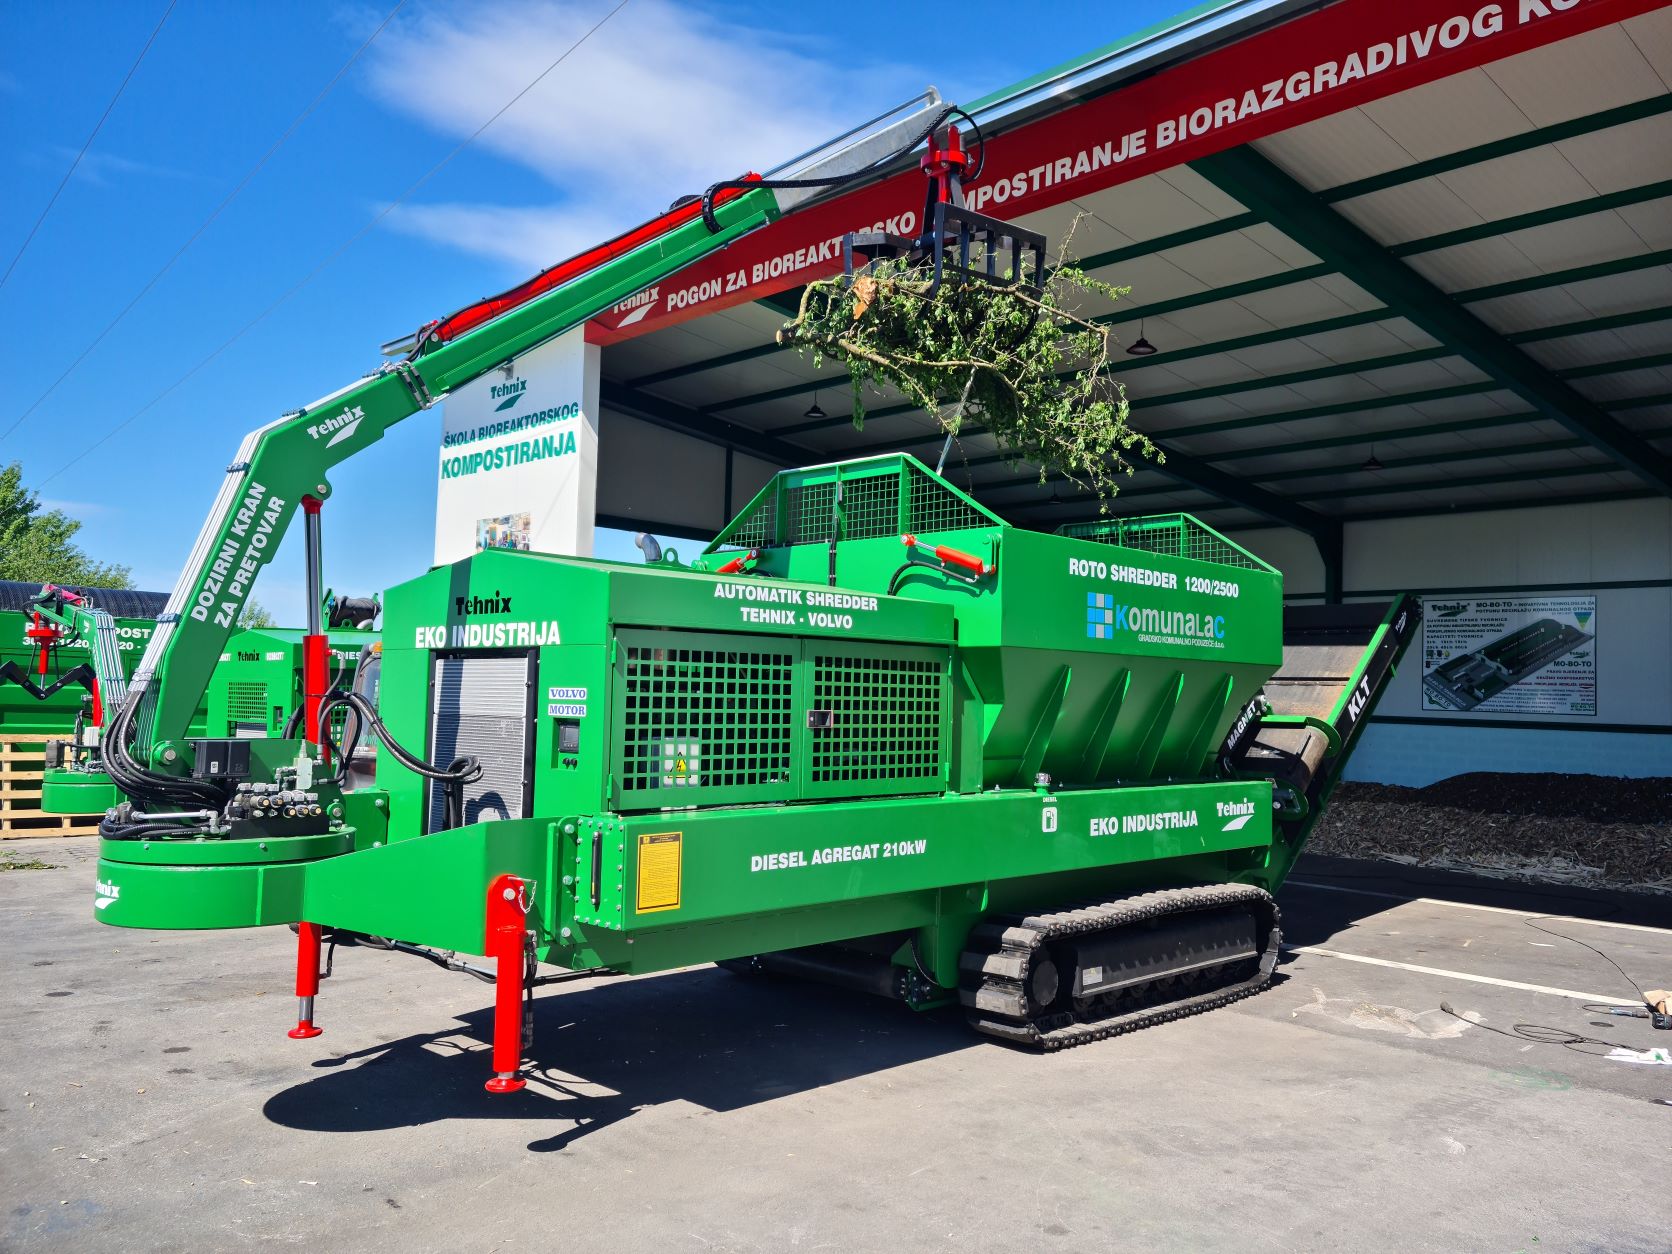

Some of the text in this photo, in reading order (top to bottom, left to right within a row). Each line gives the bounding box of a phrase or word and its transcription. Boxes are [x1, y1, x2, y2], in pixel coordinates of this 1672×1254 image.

[667, 277, 722, 312] POGON
[726, 269, 748, 293] ZA
[1156, 4, 1503, 149] BIORAZGRADIVOG
[490, 376, 527, 399] Tehnix
[307, 405, 365, 439] Tehnix
[443, 402, 579, 449] ŠKOLA BIOREAKTORSKOG
[441, 431, 576, 479] KOMPOSTIRANJA
[191, 481, 267, 622] DOZIRNI KRAN
[213, 496, 286, 629] ZA PRETOVAR
[1069, 557, 1239, 598] ROTO SHREDDER 1200/2500
[456, 590, 512, 615] Tehnix
[714, 583, 878, 611] AUTOMATIK SHREDDER
[415, 621, 561, 648] EKO INDUSTRIJA
[740, 607, 795, 625] TEHNIX
[808, 612, 852, 629] VOLVO
[549, 705, 586, 715] MOTOR
[550, 689, 586, 698] VOLVO
[1348, 674, 1370, 723] KLT
[1227, 699, 1256, 750] MAGNET
[1090, 810, 1199, 837] EKO INDUSTRIJA
[1216, 797, 1255, 817] Tehnix
[751, 839, 927, 872] DIESEL AGREGAT 210kW
